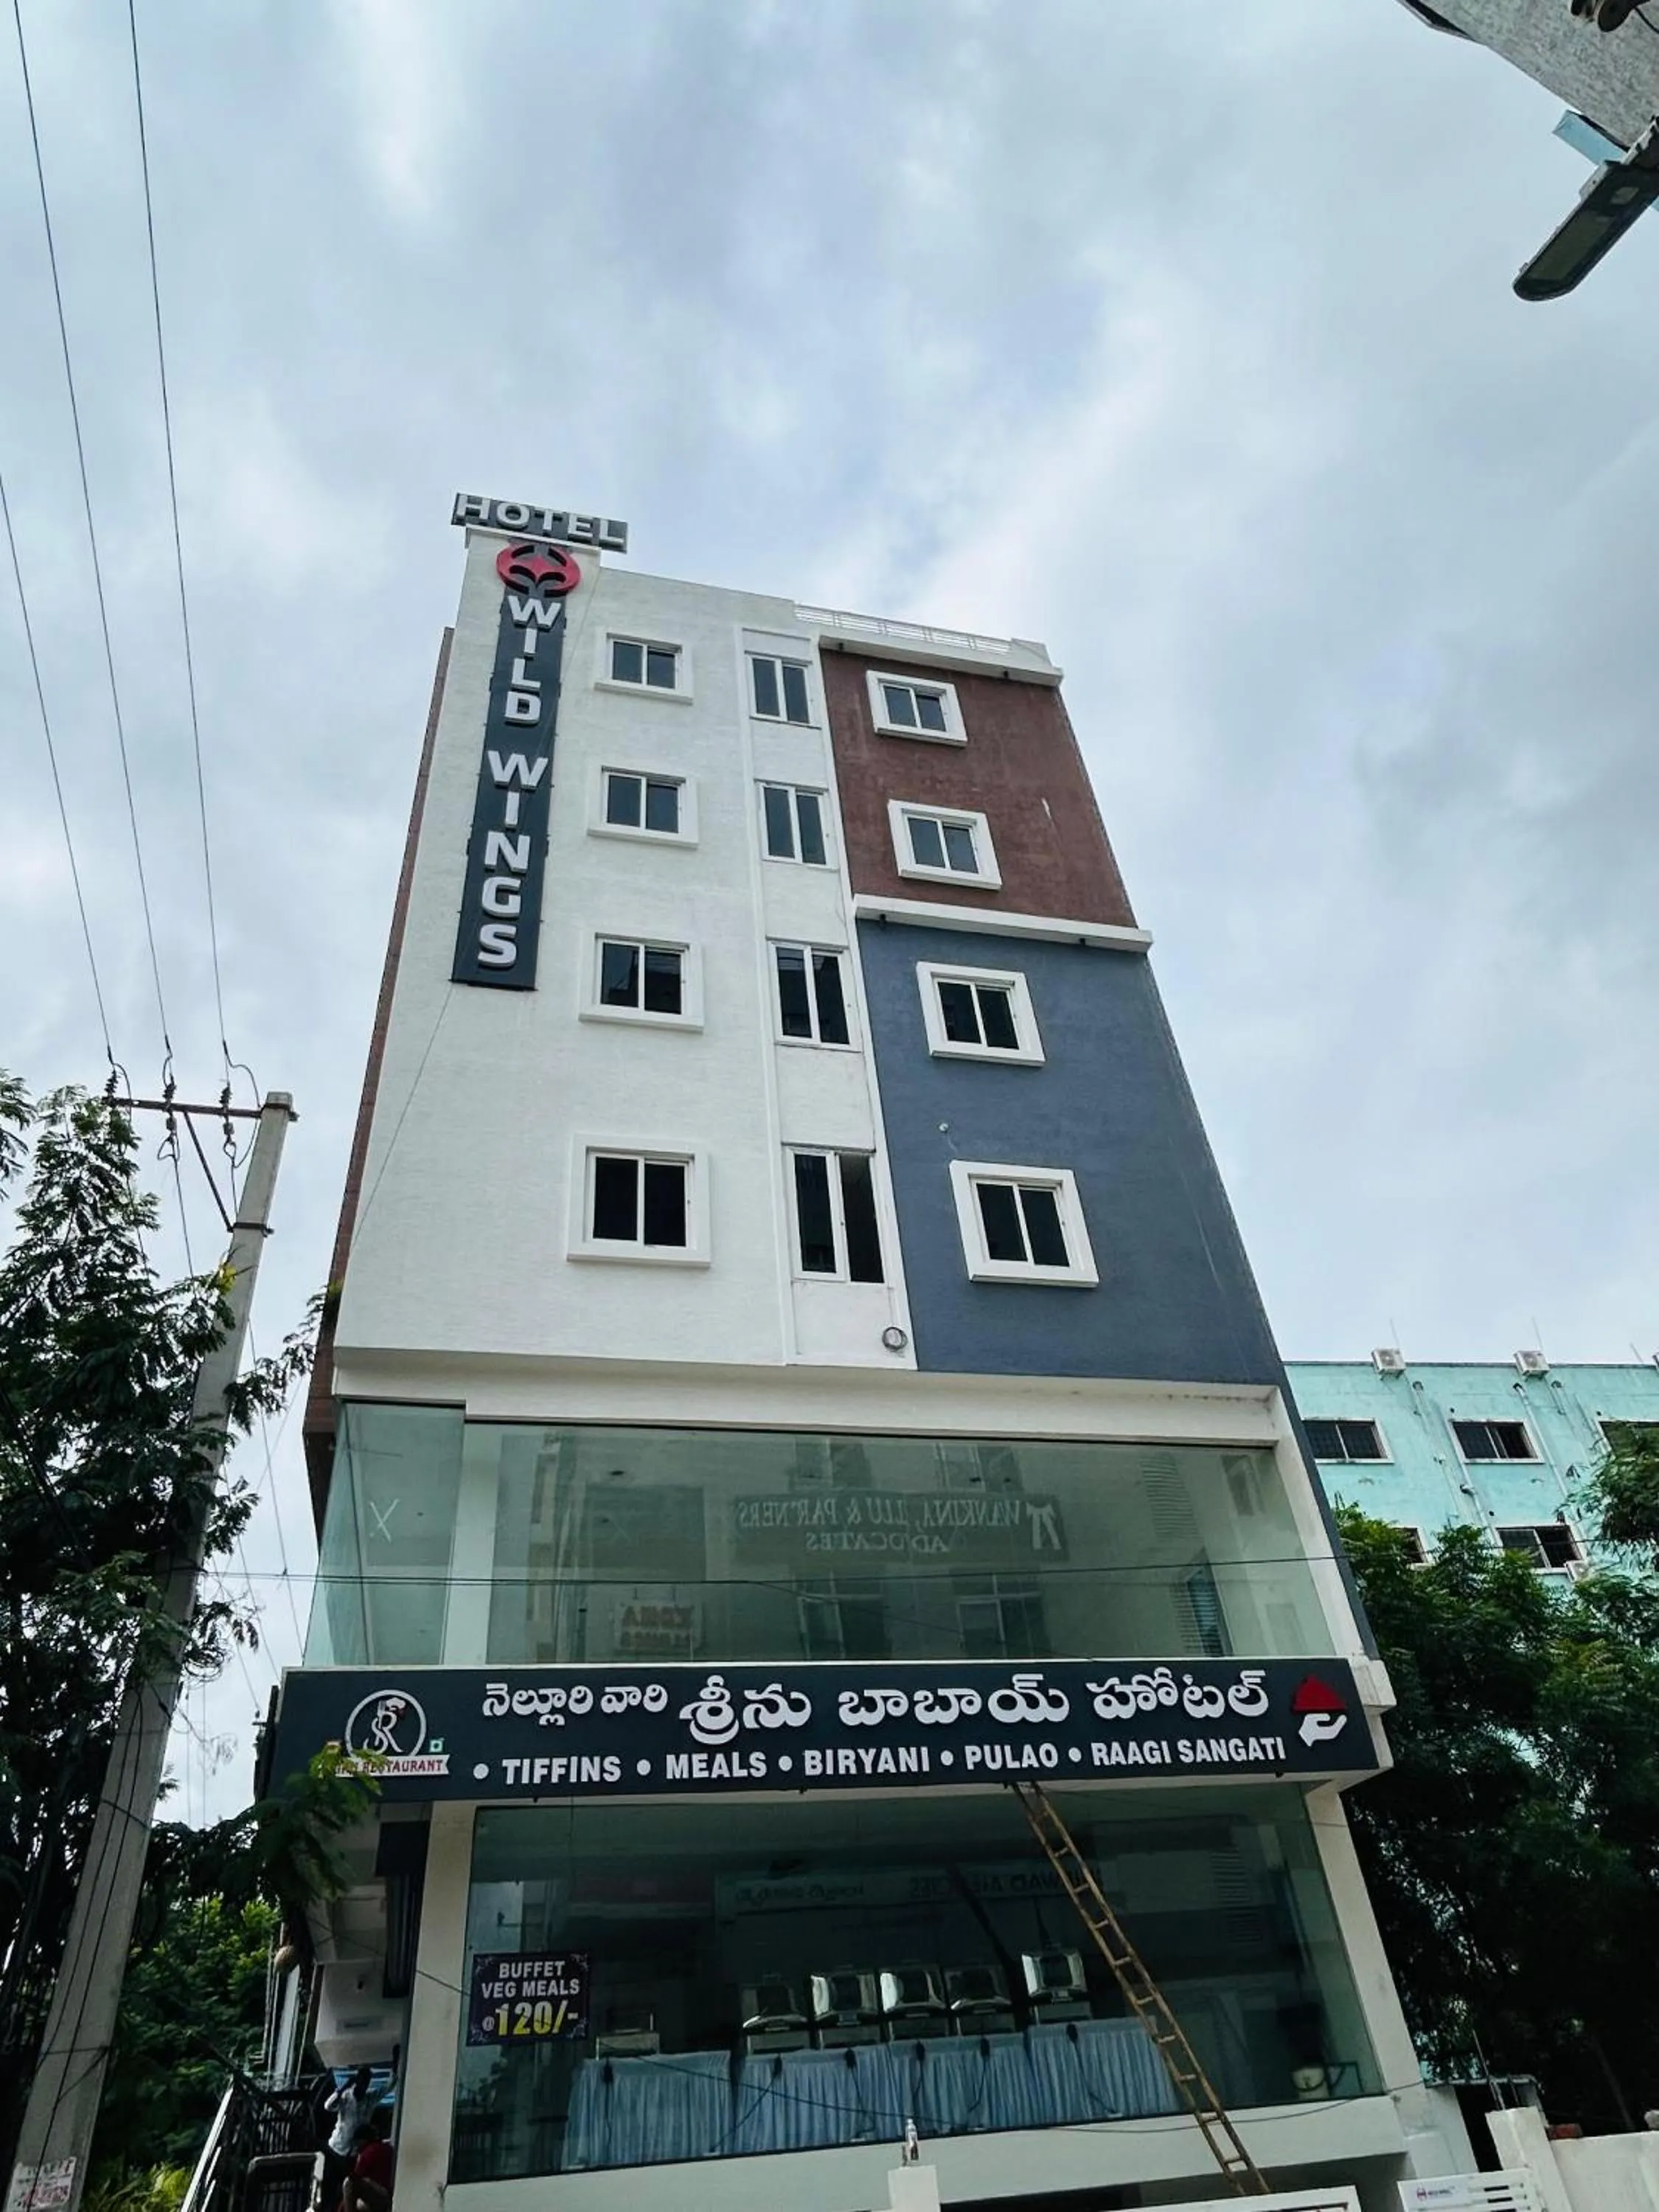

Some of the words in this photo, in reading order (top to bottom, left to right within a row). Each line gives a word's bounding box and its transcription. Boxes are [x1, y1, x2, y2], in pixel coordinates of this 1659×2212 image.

[456, 493, 625, 549] HOTEL
[504, 595, 561, 724] WILD
[478, 750, 549, 969] WINGS
[600, 1683, 668, 1713] వారి
[838, 1673, 1070, 1726] బాబాయ్
[1085, 1666, 1269, 1719] హోటల్
[502, 1756, 622, 1785] TIFFINS
[666, 1751, 768, 1779] MEALS
[803, 1747, 930, 1776] BIRYANI
[964, 1742, 1059, 1770] PULAO
[1091, 1740, 1172, 1766] RAAGI
[1177, 1736, 1286, 1763] SANGATI
[481, 1981, 516, 1999] VEG
[522, 1978, 580, 1997] MEALS
[498, 1961, 566, 1978] BUFFET
